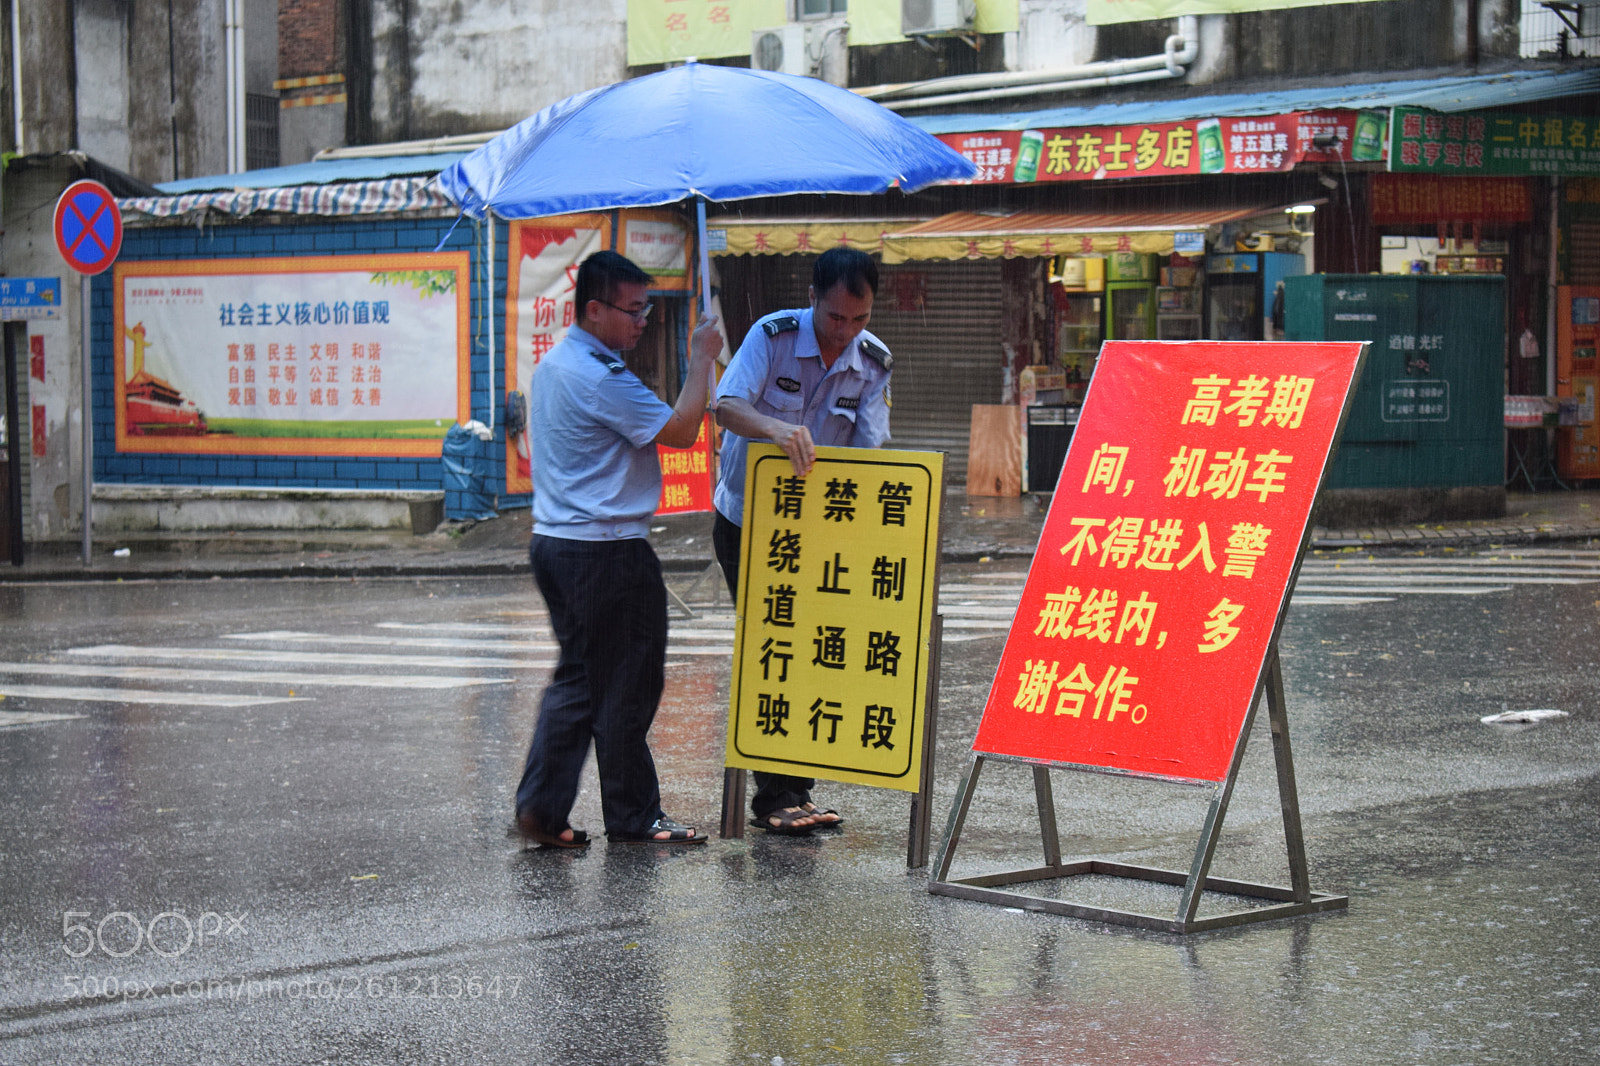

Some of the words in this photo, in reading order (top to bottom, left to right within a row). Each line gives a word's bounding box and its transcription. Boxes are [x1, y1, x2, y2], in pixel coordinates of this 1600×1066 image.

[1045, 125, 1193, 175] 东东士多店
[1230, 133, 1288, 153] 第五道菜
[754, 230, 884, 251] 东东士
[967, 235, 1132, 255] 东东士多店
[219, 300, 390, 327] 社会主义核心价值观
[227, 343, 256, 362] 富强
[268, 343, 297, 361] 民主
[310, 343, 339, 361] 文明
[352, 342, 381, 361] 和谐
[229, 365, 256, 384] 自由
[268, 365, 297, 383] 平等
[309, 365, 339, 383] 公正
[352, 364, 382, 383] 法治
[228, 387, 256, 406] 爱国
[268, 388, 297, 406] 敬业
[310, 388, 339, 406] 诚信
[352, 388, 381, 406] 友善
[1181, 374, 1315, 429] 高考期
[659, 451, 707, 475] 员不得进入警戒
[1060, 516, 1272, 579] 不得进入警
[756, 475, 806, 737] 请绕道行驶
[808, 478, 858, 743] 禁止通行
[861, 481, 913, 750] 管制路段
[1013, 659, 1148, 724] 谢合作。
